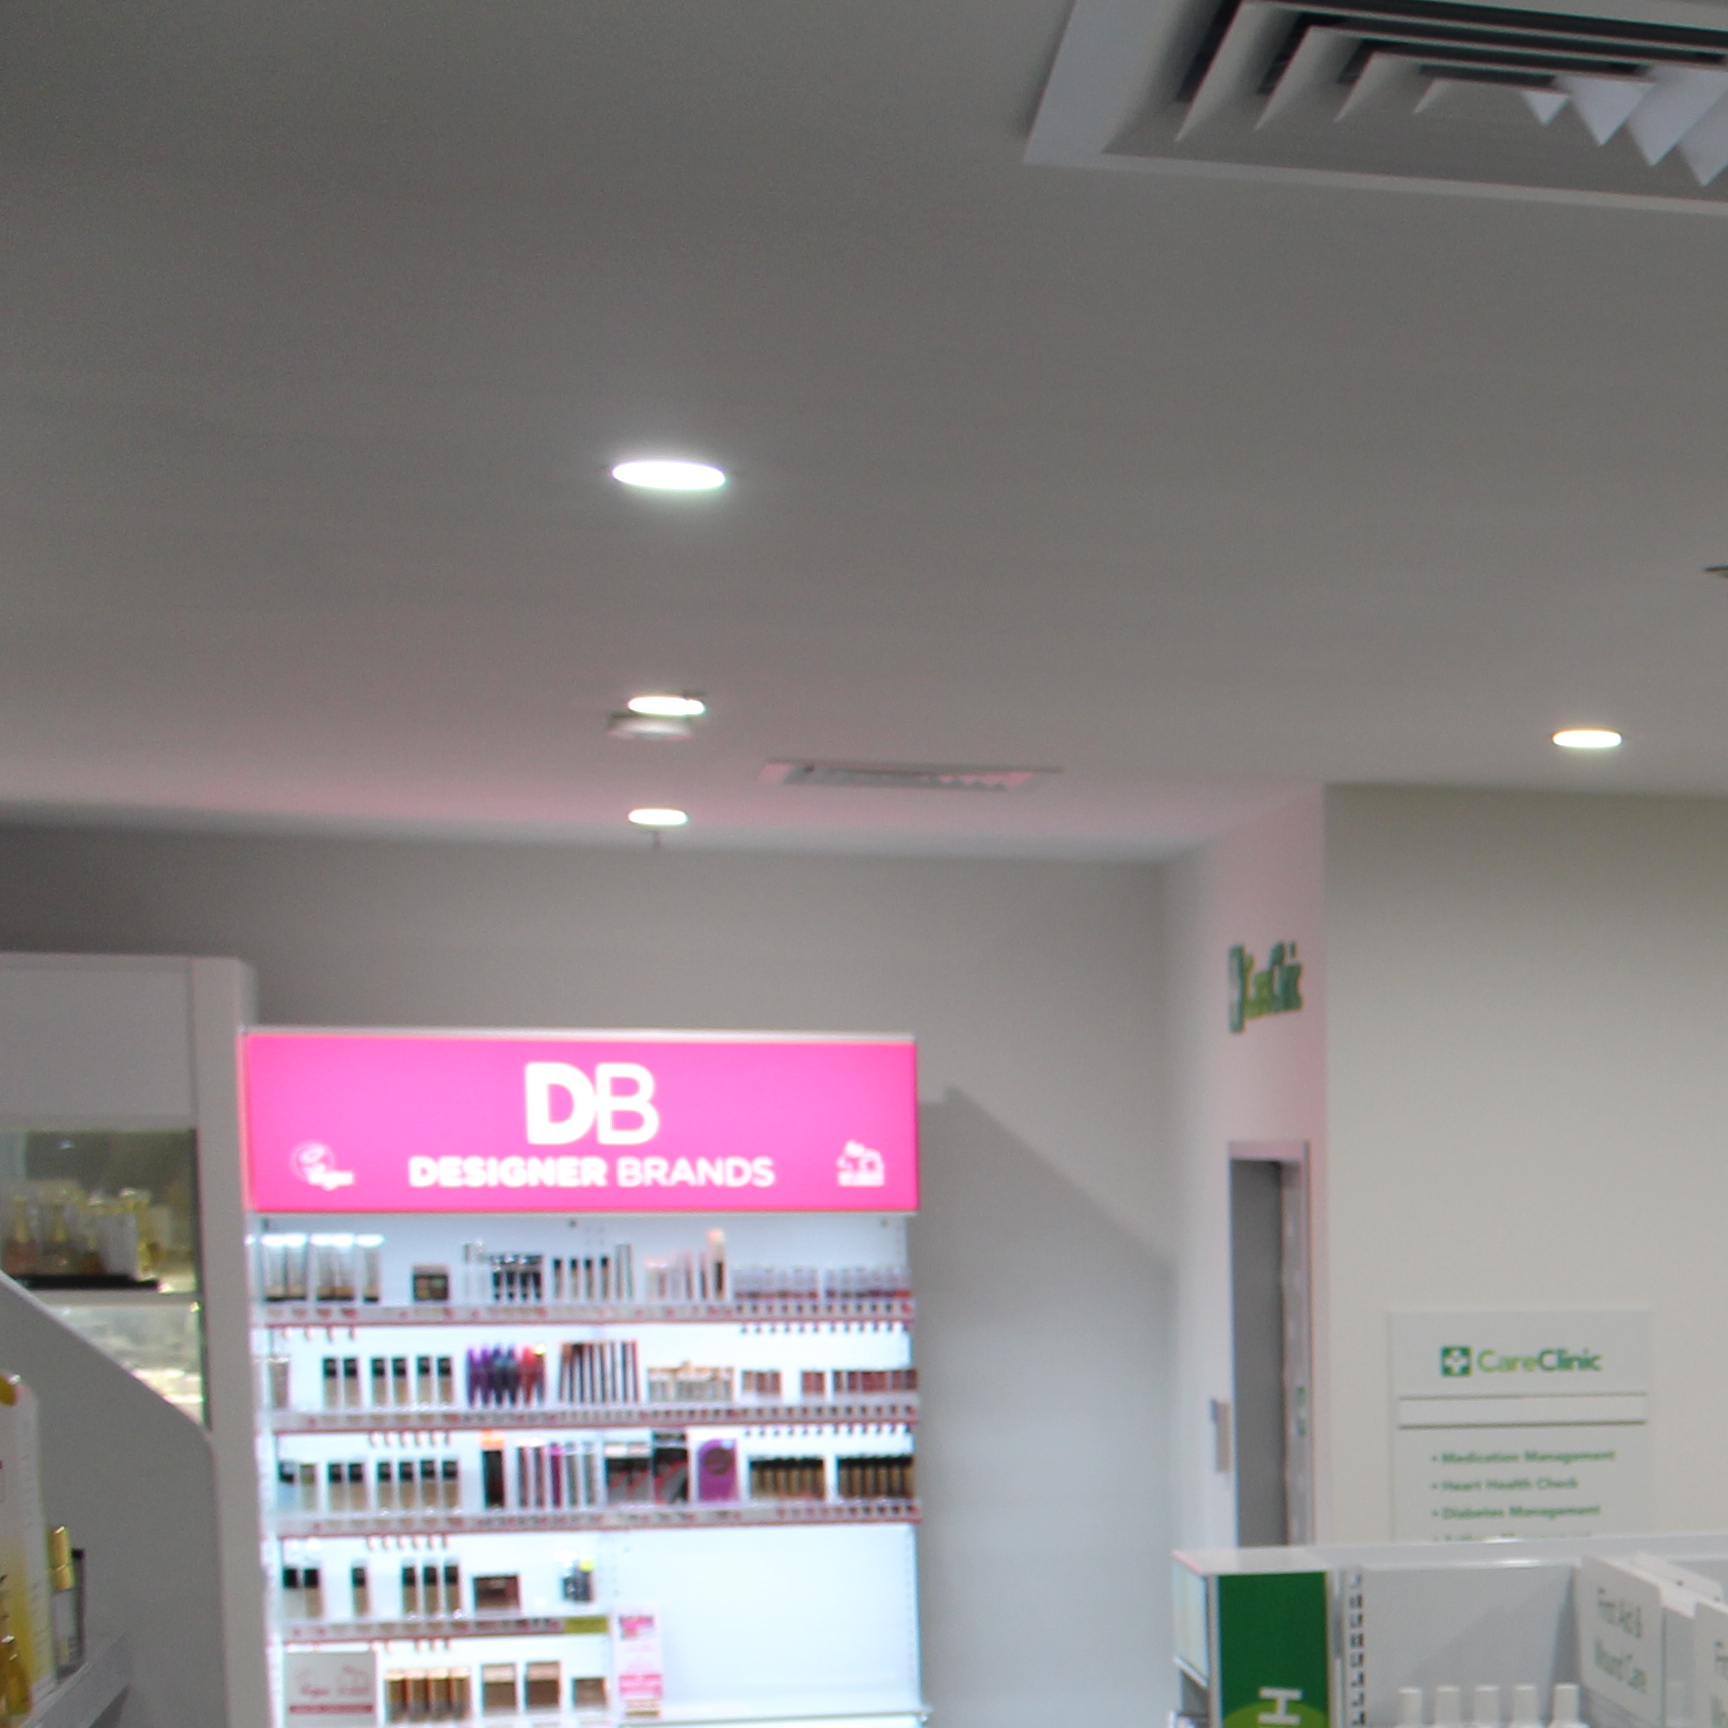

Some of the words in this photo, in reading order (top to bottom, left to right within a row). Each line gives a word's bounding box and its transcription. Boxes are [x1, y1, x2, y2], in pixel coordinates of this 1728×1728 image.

[525, 1061, 659, 1145] DB
[408, 1156, 607, 1187] DESIGNER
[617, 1156, 774, 1187] BRANDS
[1477, 1350, 1602, 1373] CareClinic
